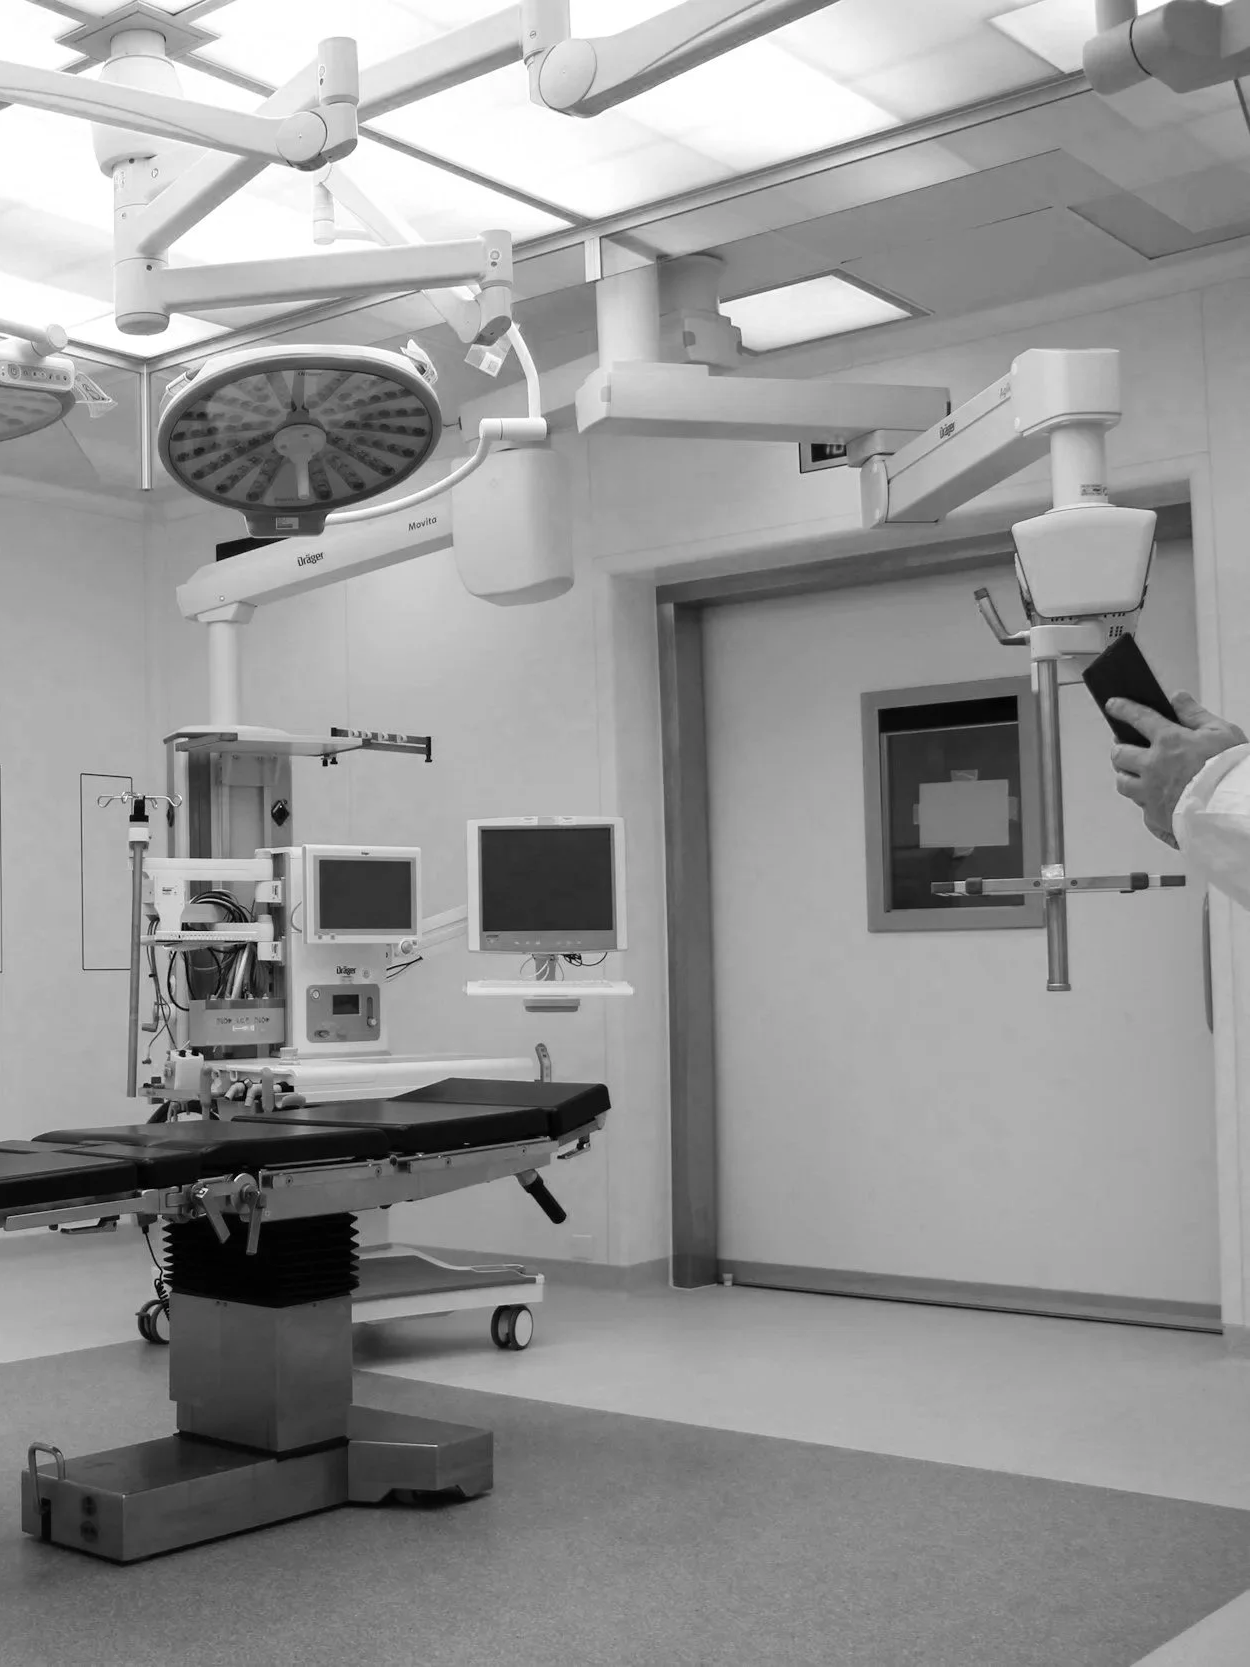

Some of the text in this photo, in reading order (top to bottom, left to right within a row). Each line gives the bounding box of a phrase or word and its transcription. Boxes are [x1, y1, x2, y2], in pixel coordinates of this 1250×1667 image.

[408, 516, 438, 532] Movita
[297, 550, 325, 567] Dräger
[336, 966, 356, 976] Dräger
